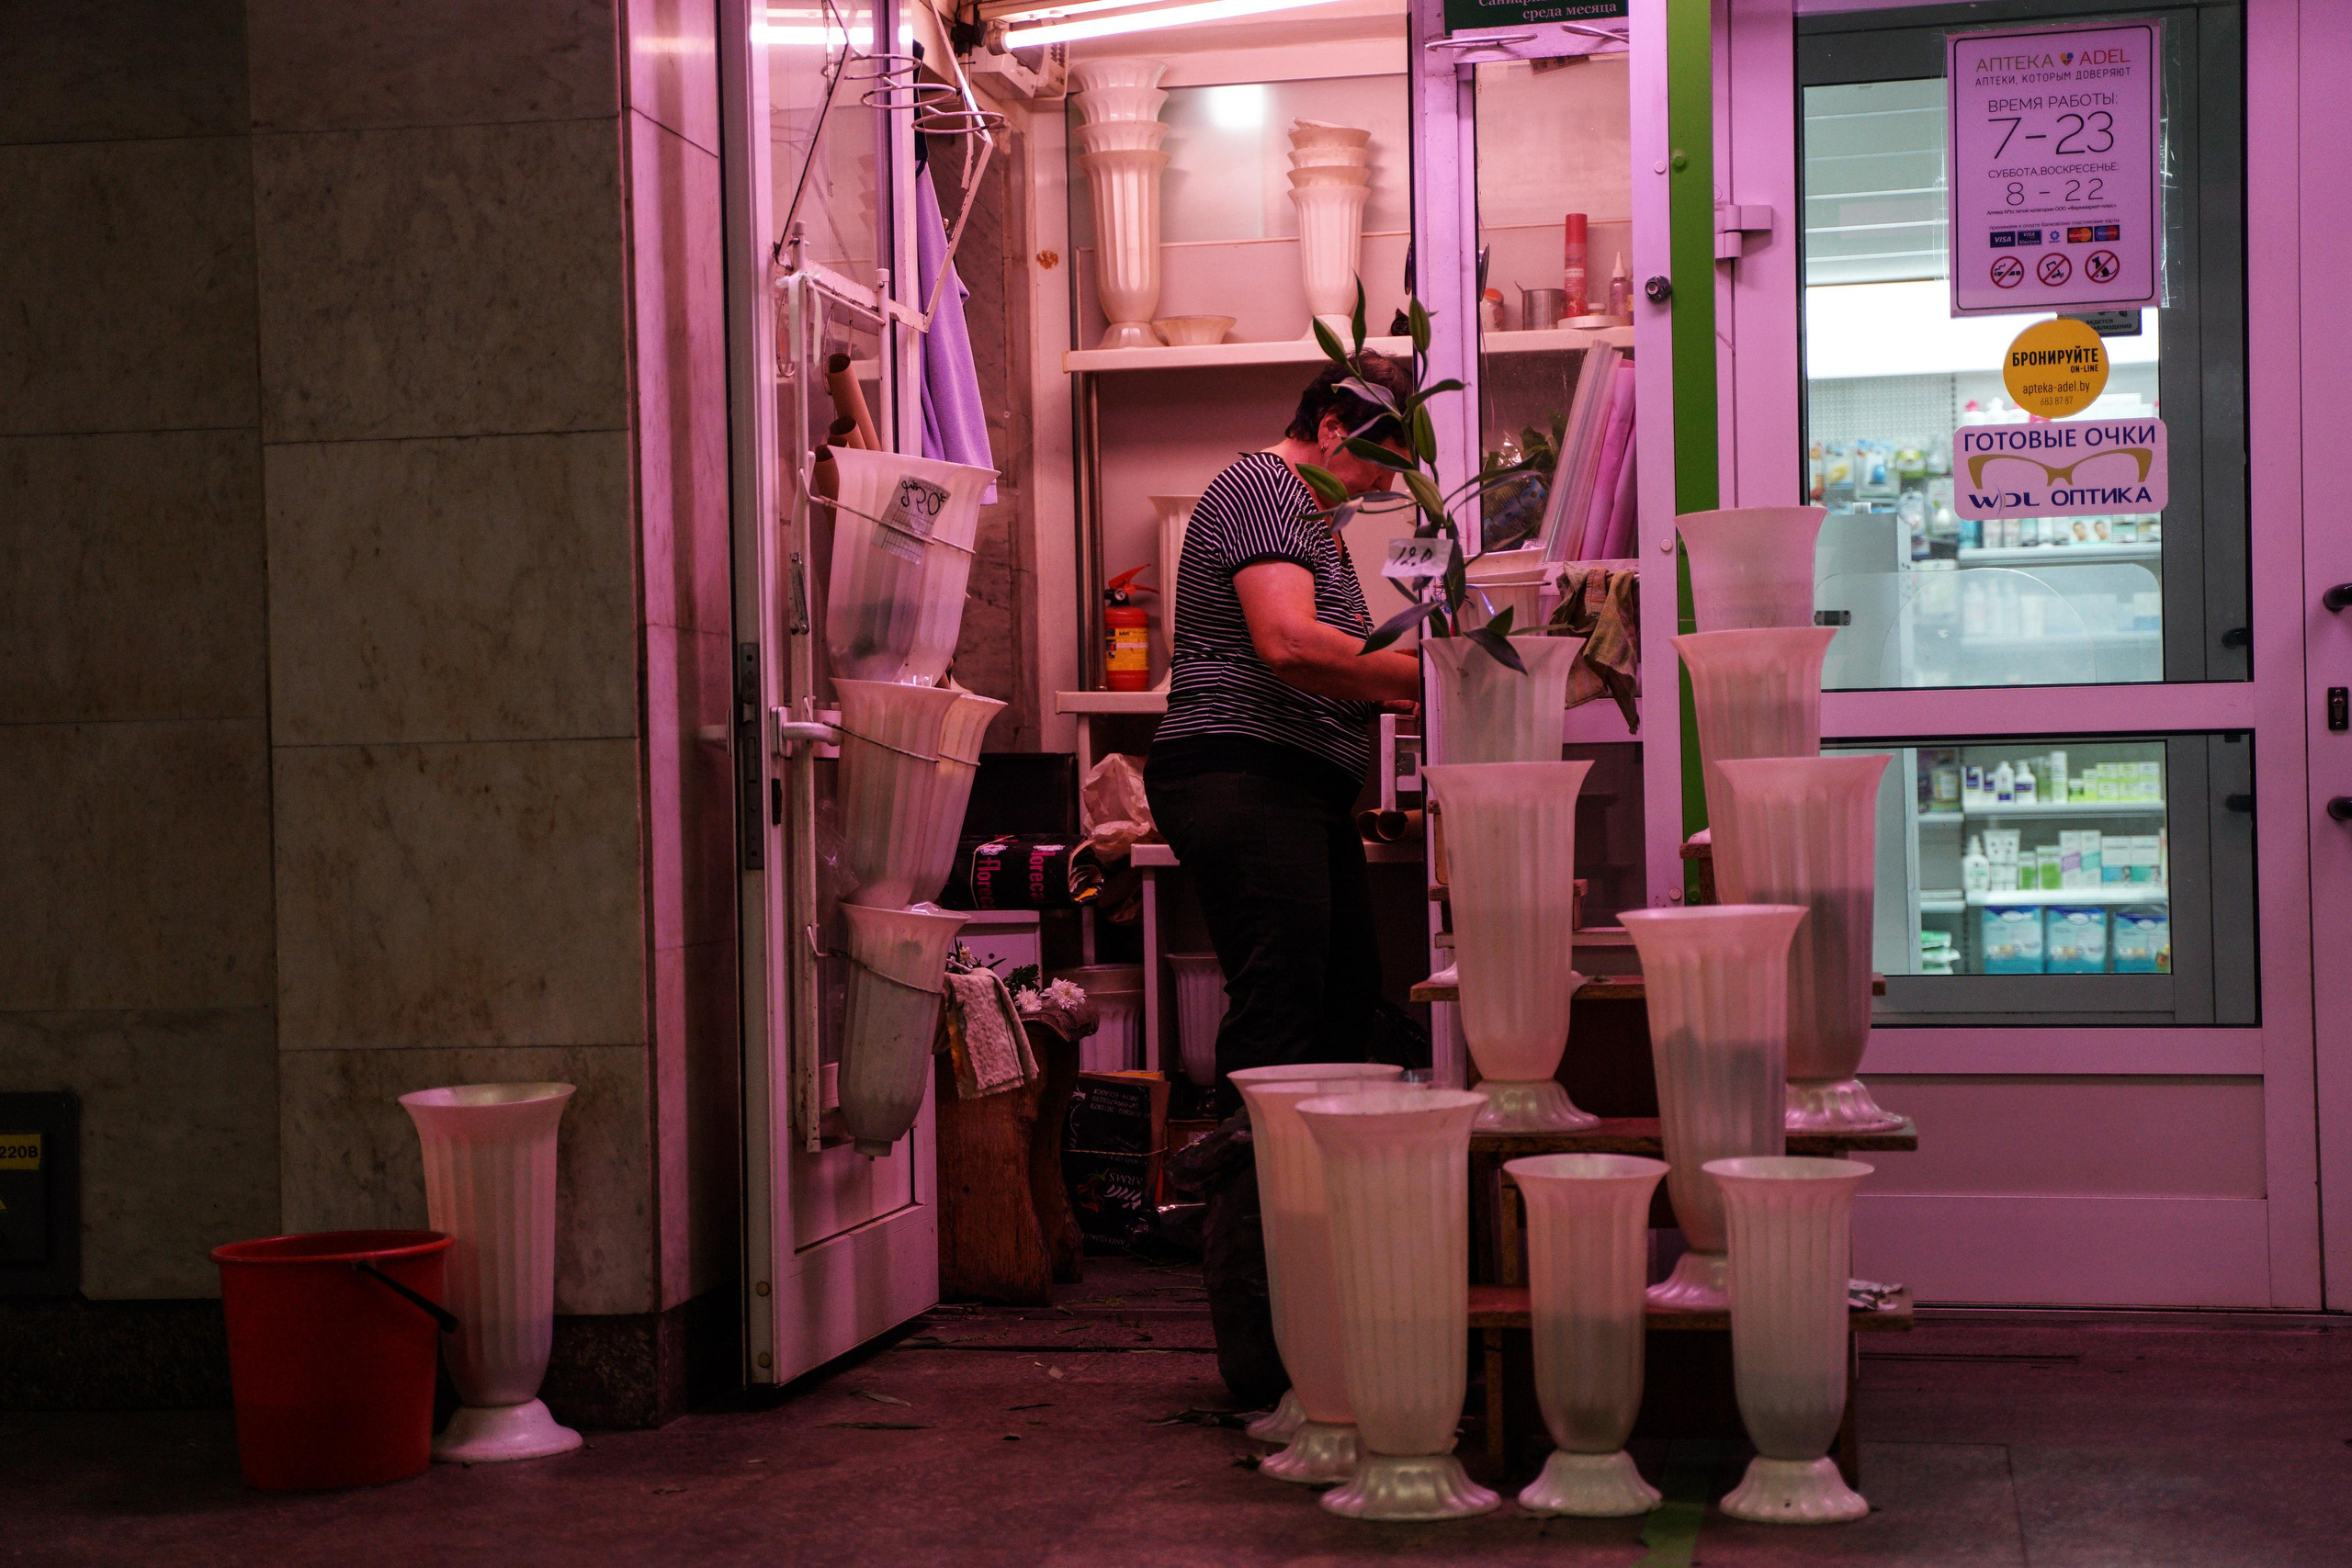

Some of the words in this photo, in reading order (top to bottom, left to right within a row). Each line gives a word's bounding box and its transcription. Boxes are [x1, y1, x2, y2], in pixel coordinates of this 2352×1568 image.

[1522, 8, 1562, 21] среда
[1566, 4, 1617, 16] месяца
[1976, 54, 2054, 73] АПТЕКА
[2079, 49, 2131, 65] ADEL
[1975, 75, 2018, 86] АПТЕКИ,
[2021, 72, 2072, 84] КОТОРЫМ
[2075, 67, 2132, 80] ДОВЕРЯЮТ
[1988, 97, 2042, 113] ВРЕМЯ
[2048, 93, 2119, 108] РАБОТЫ:
[2012, 346, 2099, 367] БРОНИРУЙТЕ
[2070, 365, 2099, 373] ON-LINE
[2022, 380, 2090, 395] apteka-adel.by
[2040, 397, 2053, 406] 683
[2054, 396, 2064, 405] 87
[2064, 395, 2074, 404] 87
[1964, 429, 2077, 452] ГОТОВЫЕ
[2085, 425, 2155, 446] ОЧКИ
[2052, 487, 2153, 506] ОПТИКА
